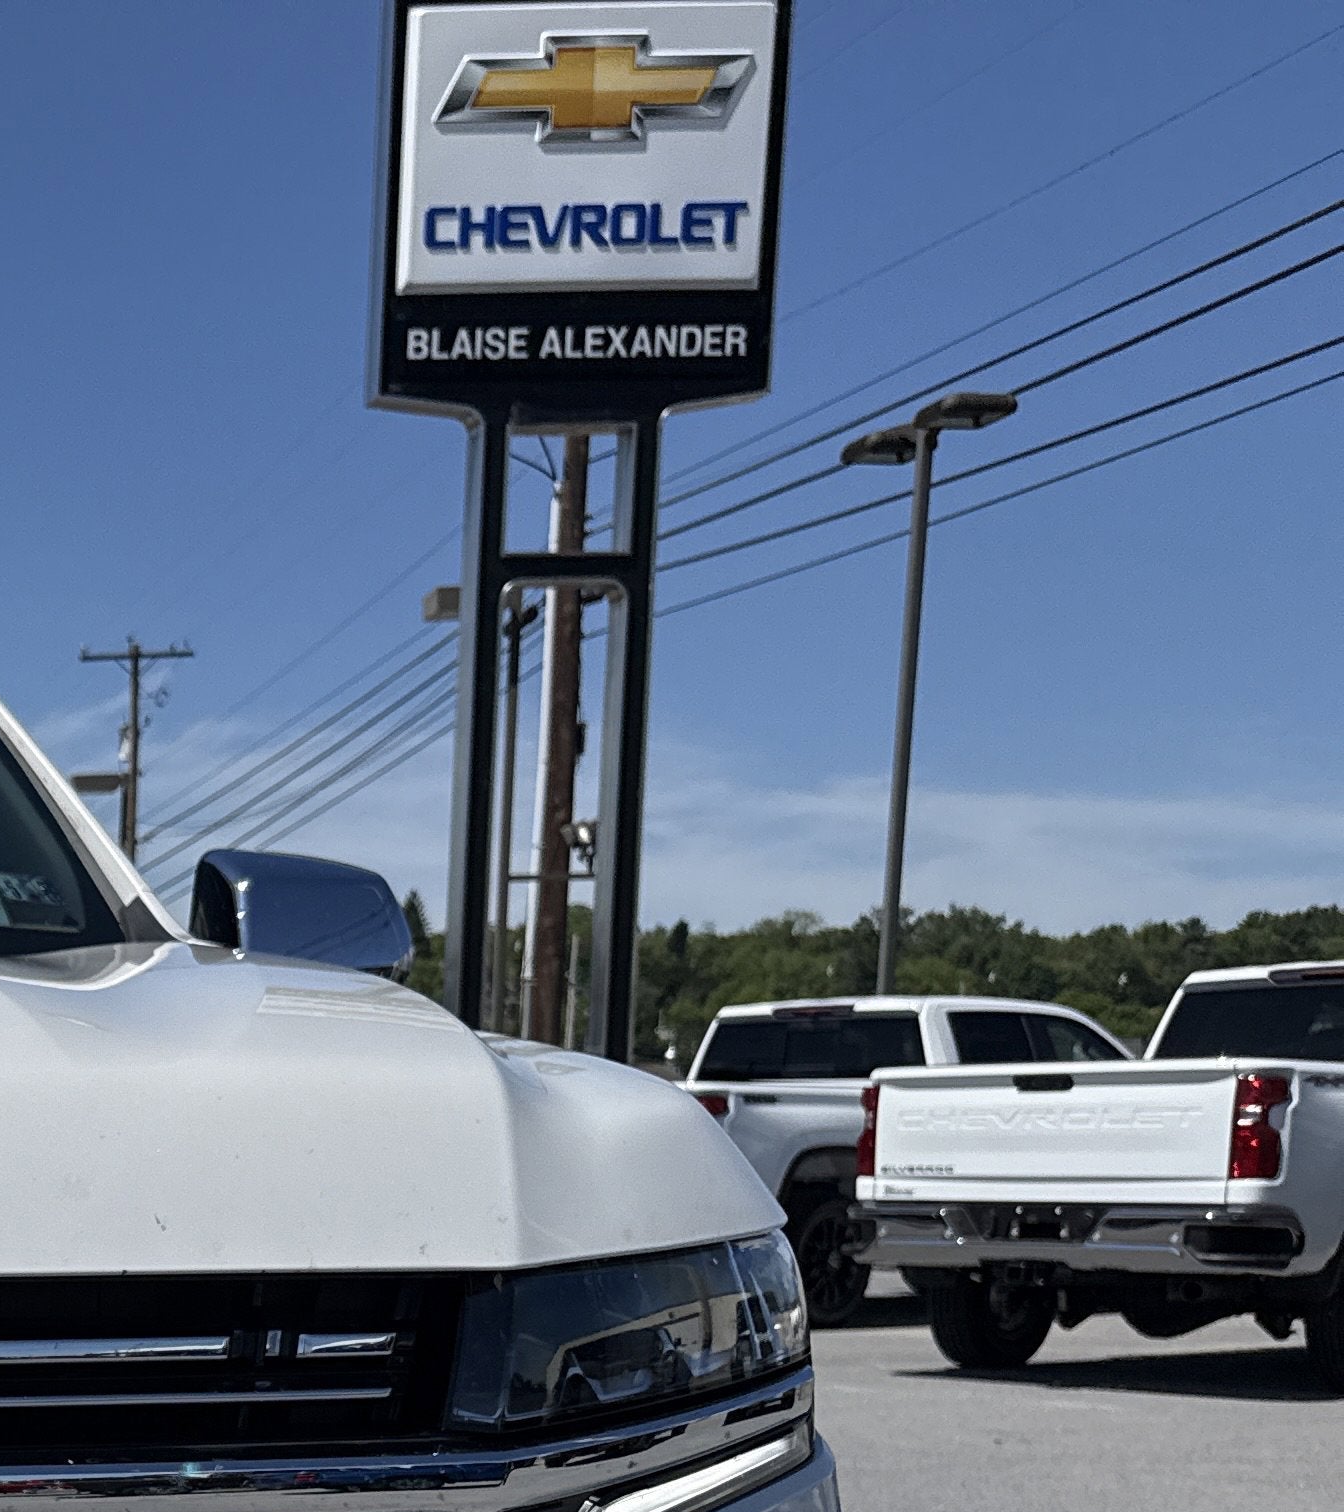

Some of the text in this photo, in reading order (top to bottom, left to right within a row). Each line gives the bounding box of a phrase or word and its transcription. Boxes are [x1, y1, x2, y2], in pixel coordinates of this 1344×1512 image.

[423, 201, 749, 250] CHEVROLET
[406, 324, 749, 361] BLAISE ALEXANDER
[898, 1104, 1203, 1132] CHEVROLET
